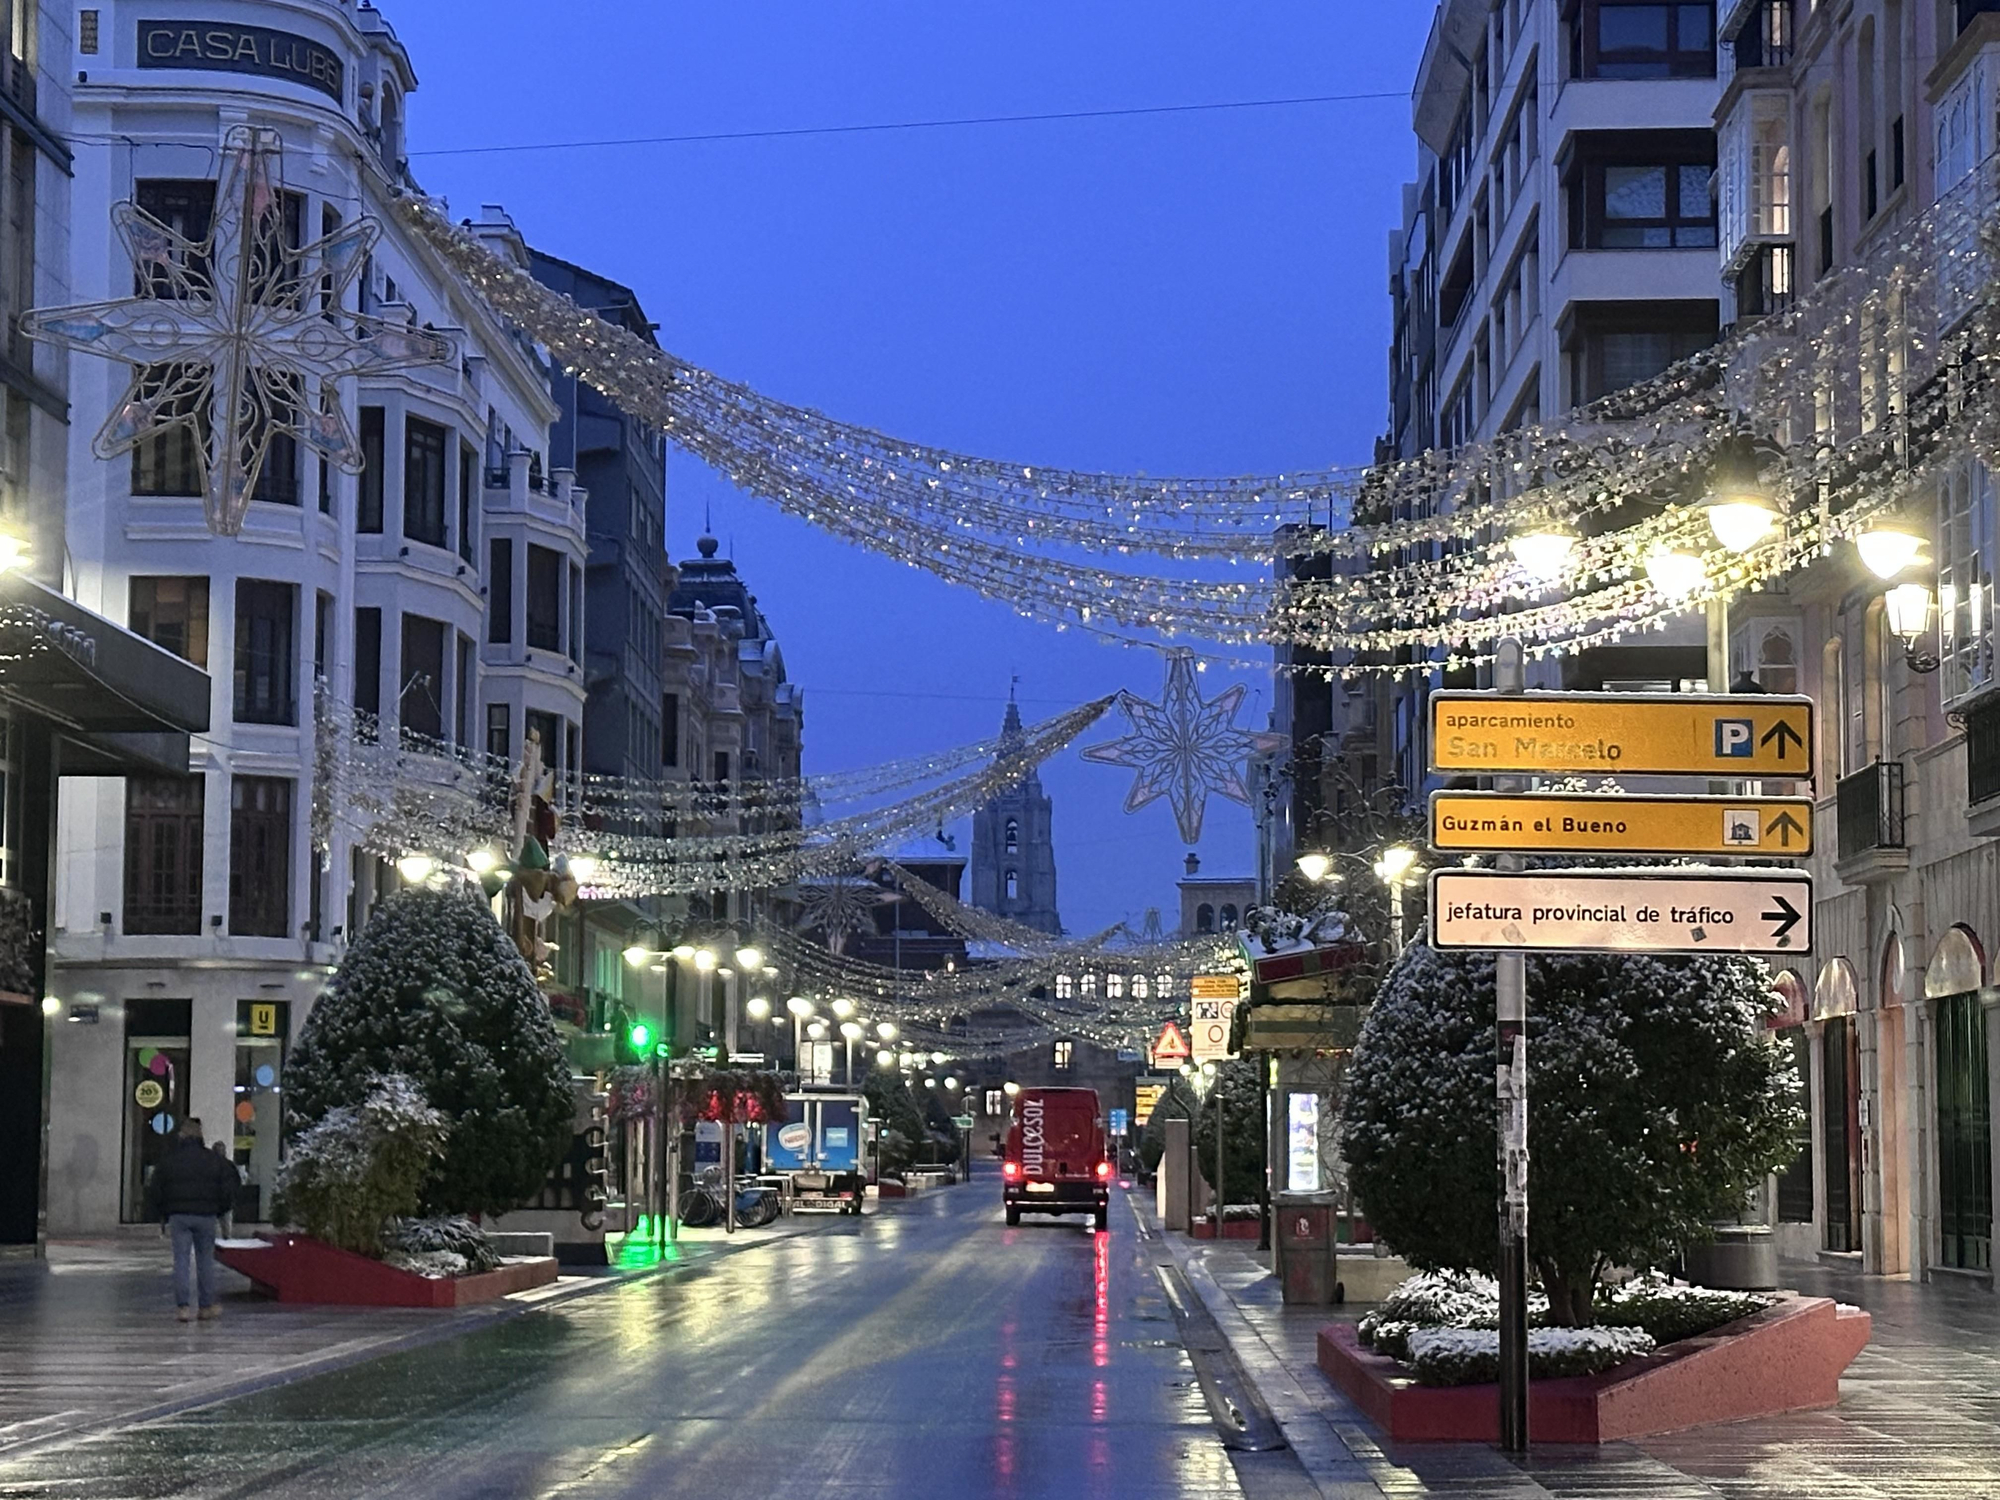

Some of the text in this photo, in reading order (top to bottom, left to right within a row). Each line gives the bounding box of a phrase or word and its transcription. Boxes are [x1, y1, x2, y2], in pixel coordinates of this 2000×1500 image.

[147, 29, 261, 64] CASA
[1445, 713, 1575, 730] aparcamiento
[1447, 736, 1498, 758] San
[1721, 722, 1750, 755] P
[1442, 814, 1627, 833] Guzmán el Bueno
[1446, 902, 1734, 924] jefatura provincial de tráfico
